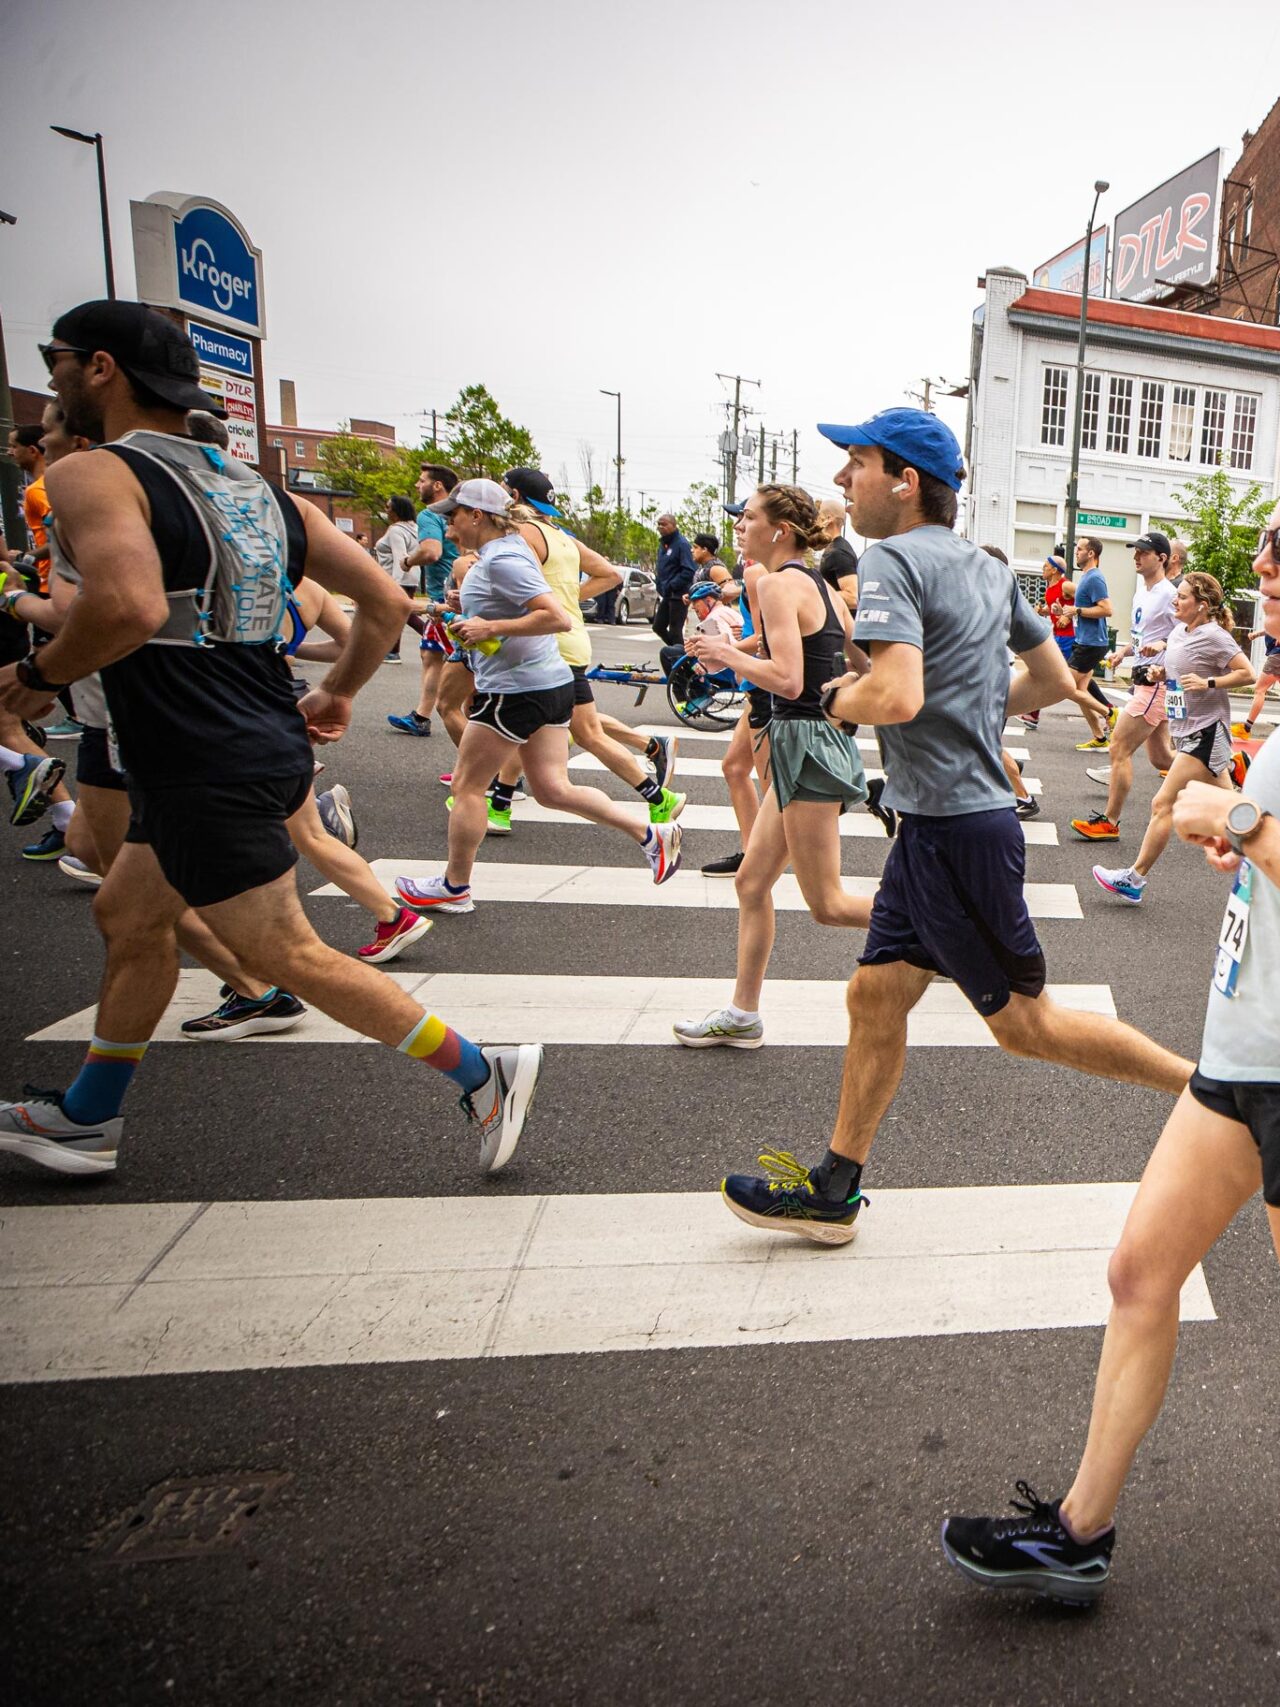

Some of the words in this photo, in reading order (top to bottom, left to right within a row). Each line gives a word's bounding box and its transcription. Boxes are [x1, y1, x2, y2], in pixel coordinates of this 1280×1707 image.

[1116, 192, 1211, 293] DTLR
[181, 238, 252, 311] Kroger
[192, 331, 248, 366] Pharmacy
[225, 380, 252, 399] DTLR
[228, 424, 255, 438] cricket
[231, 448, 255, 461] Nails
[1087, 515, 1111, 526] BROAD
[1224, 909, 1245, 952] 74
